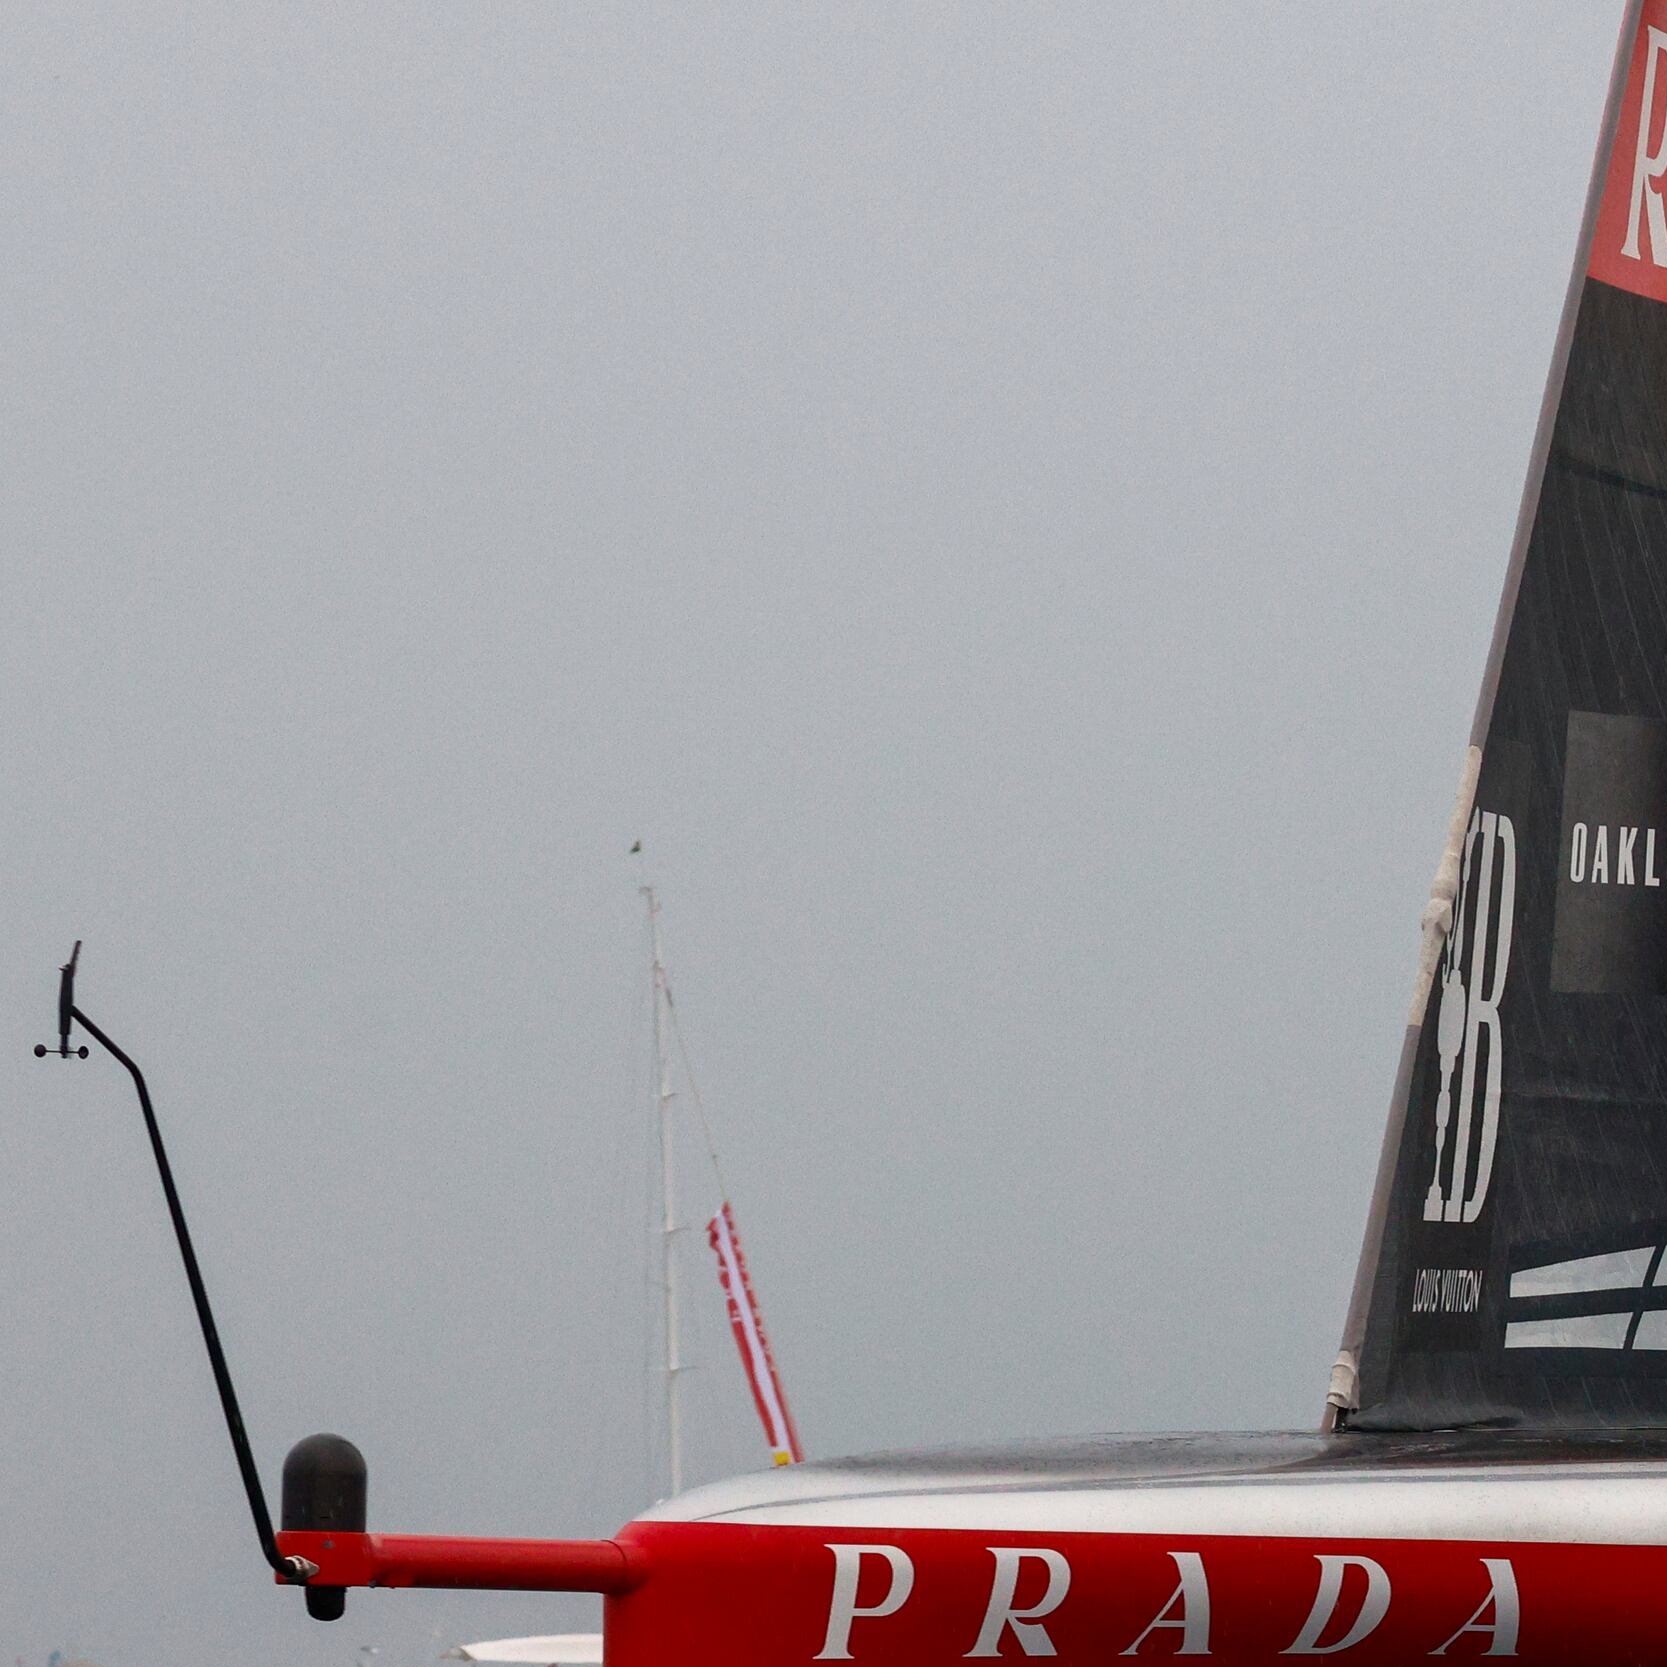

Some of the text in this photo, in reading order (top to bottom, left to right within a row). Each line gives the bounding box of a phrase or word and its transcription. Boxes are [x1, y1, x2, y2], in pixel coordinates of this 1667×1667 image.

[1412, 1268, 1483, 1313] LOUIS VUITTON
[812, 1542, 1521, 1660] PRADA
